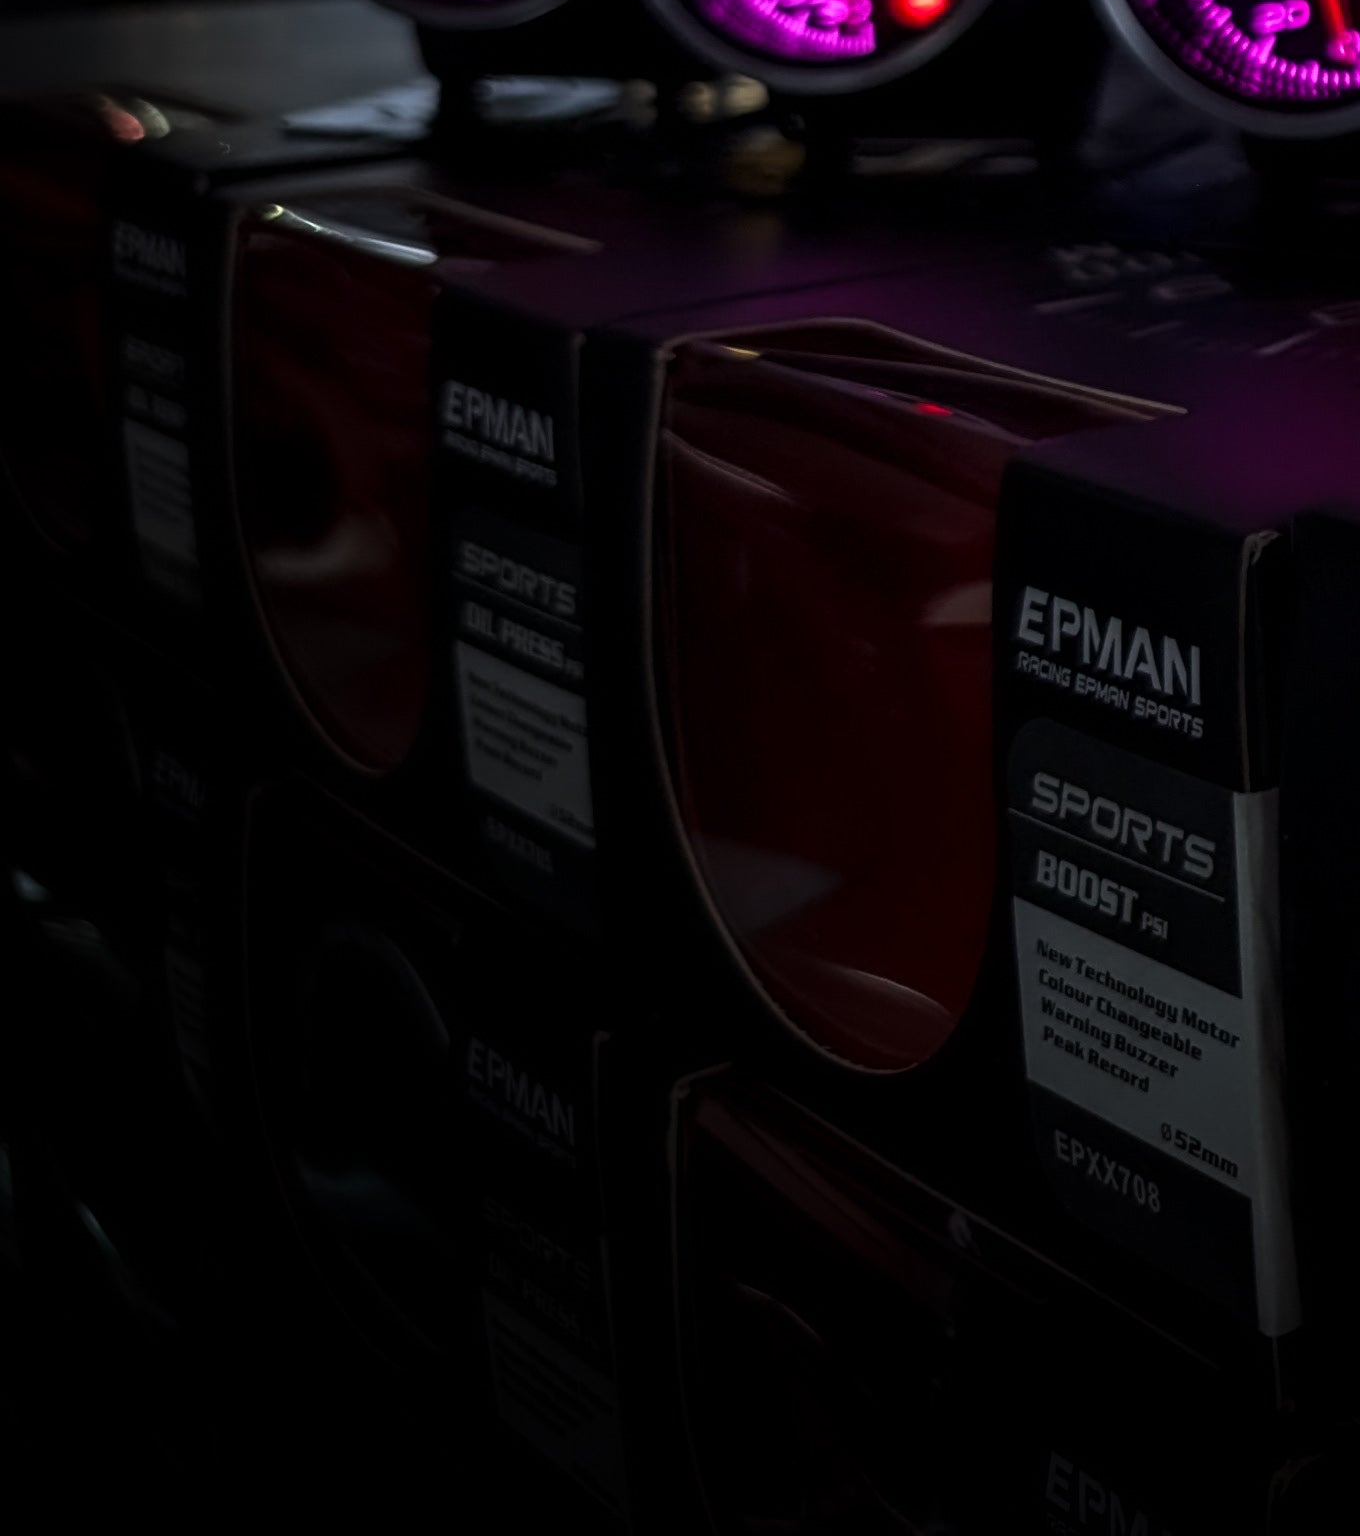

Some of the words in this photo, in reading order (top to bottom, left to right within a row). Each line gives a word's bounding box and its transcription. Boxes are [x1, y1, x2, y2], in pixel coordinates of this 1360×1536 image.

[440, 379, 555, 463] EPMAN
[460, 539, 577, 616] SPORTS
[1017, 585, 1201, 707] EPMAN
[1017, 650, 1071, 688] RACING
[1073, 673, 1130, 710] EPMAN
[1133, 695, 1205, 739] SPORTS
[1031, 771, 1217, 880] SPORTS
[1037, 849, 1140, 924] BOOST
[1140, 911, 1169, 941] PSI
[1036, 938, 1073, 970] New
[1075, 956, 1179, 1024] Technology
[1181, 1007, 1241, 1048] Motor
[1038, 968, 1094, 1007] Colour
[1096, 996, 1203, 1061] Changeable
[1040, 996, 1112, 1049] Warning
[1114, 1034, 1179, 1078] Buzzer
[466, 1036, 576, 1147] EPMAN
[1043, 1025, 1085, 1060] Peak
[1087, 1048, 1151, 1093] Record
[1053, 1128, 1162, 1214] EPXX708
